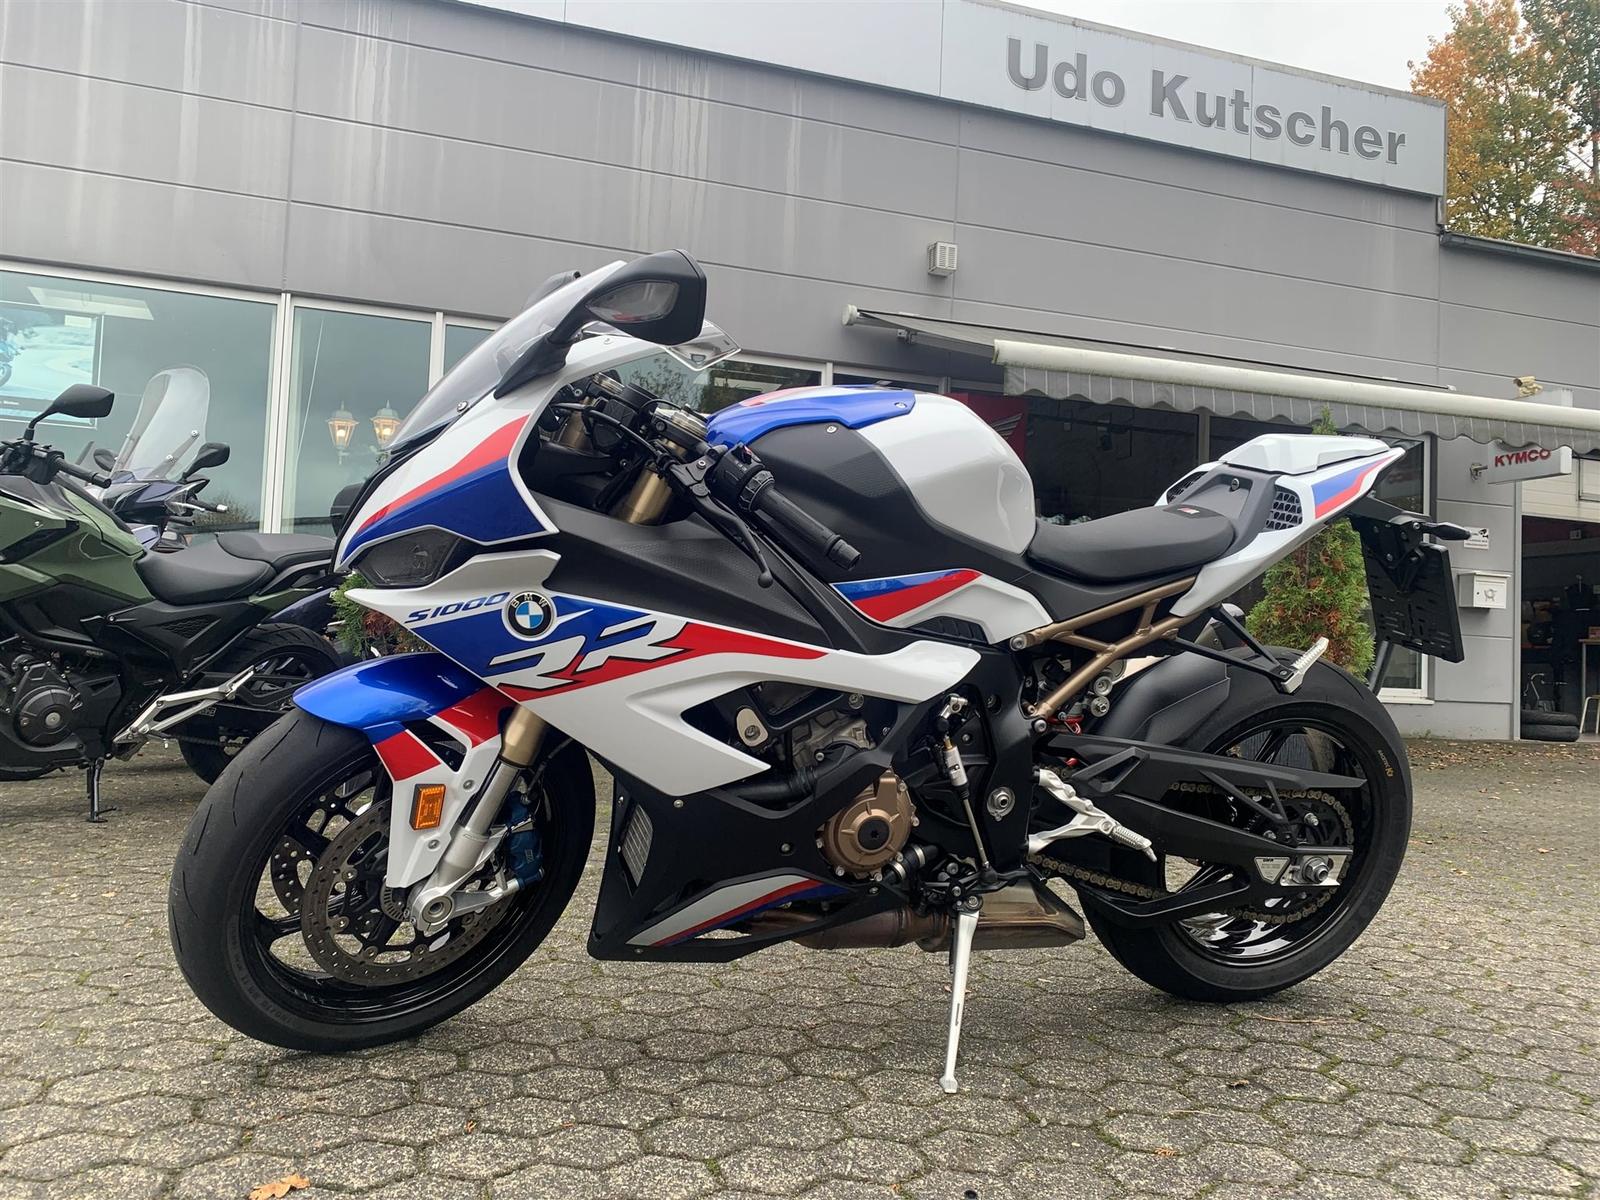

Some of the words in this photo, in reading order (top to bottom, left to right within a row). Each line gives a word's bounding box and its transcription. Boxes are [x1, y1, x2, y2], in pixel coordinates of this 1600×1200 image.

[1007, 37, 1126, 107] Udo
[1150, 69, 1406, 165] Kutscher
[1494, 448, 1551, 468] KYMCO
[404, 591, 510, 624] S1000
[510, 593, 548, 608] BMW
